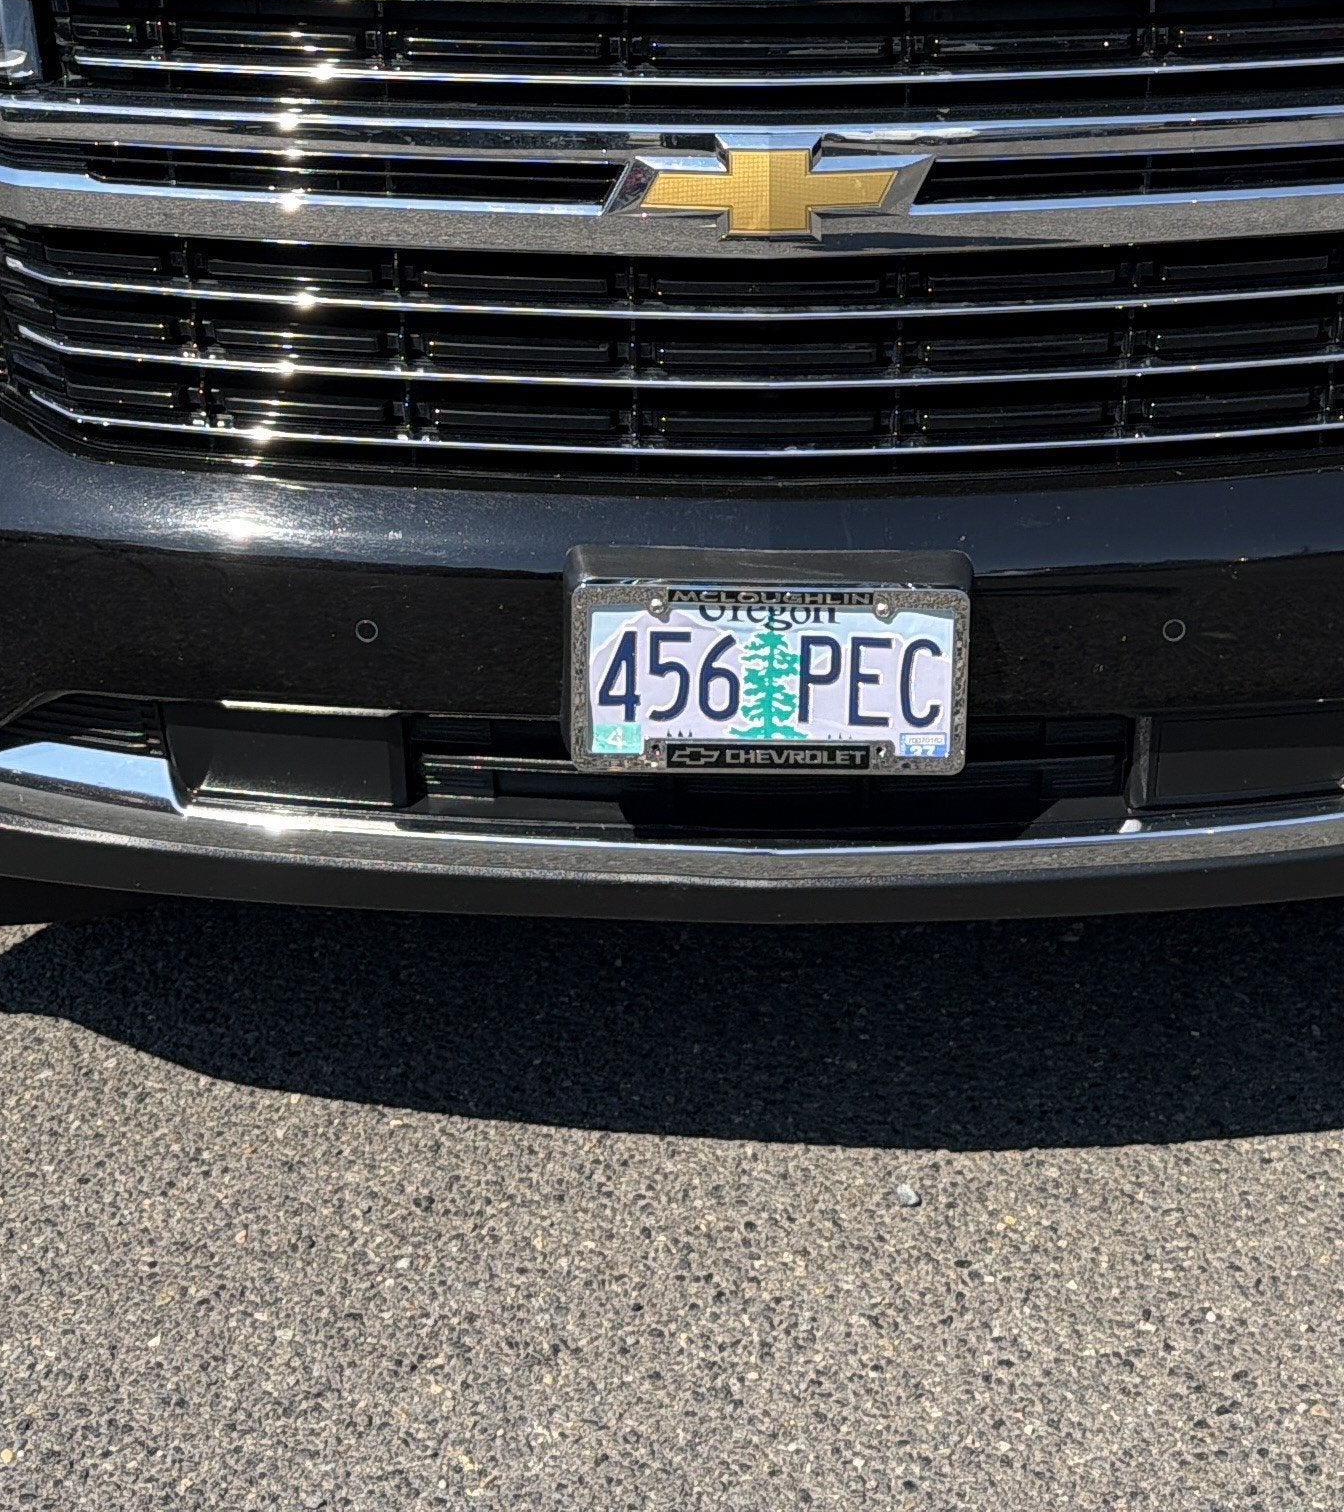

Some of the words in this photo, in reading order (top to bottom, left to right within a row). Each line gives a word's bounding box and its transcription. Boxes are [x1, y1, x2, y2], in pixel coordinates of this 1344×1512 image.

[672, 590, 870, 605] MCLOUGHLIN
[598, 630, 741, 722] 456
[798, 635, 943, 728] PEC
[725, 748, 867, 765] CHEVROLET
